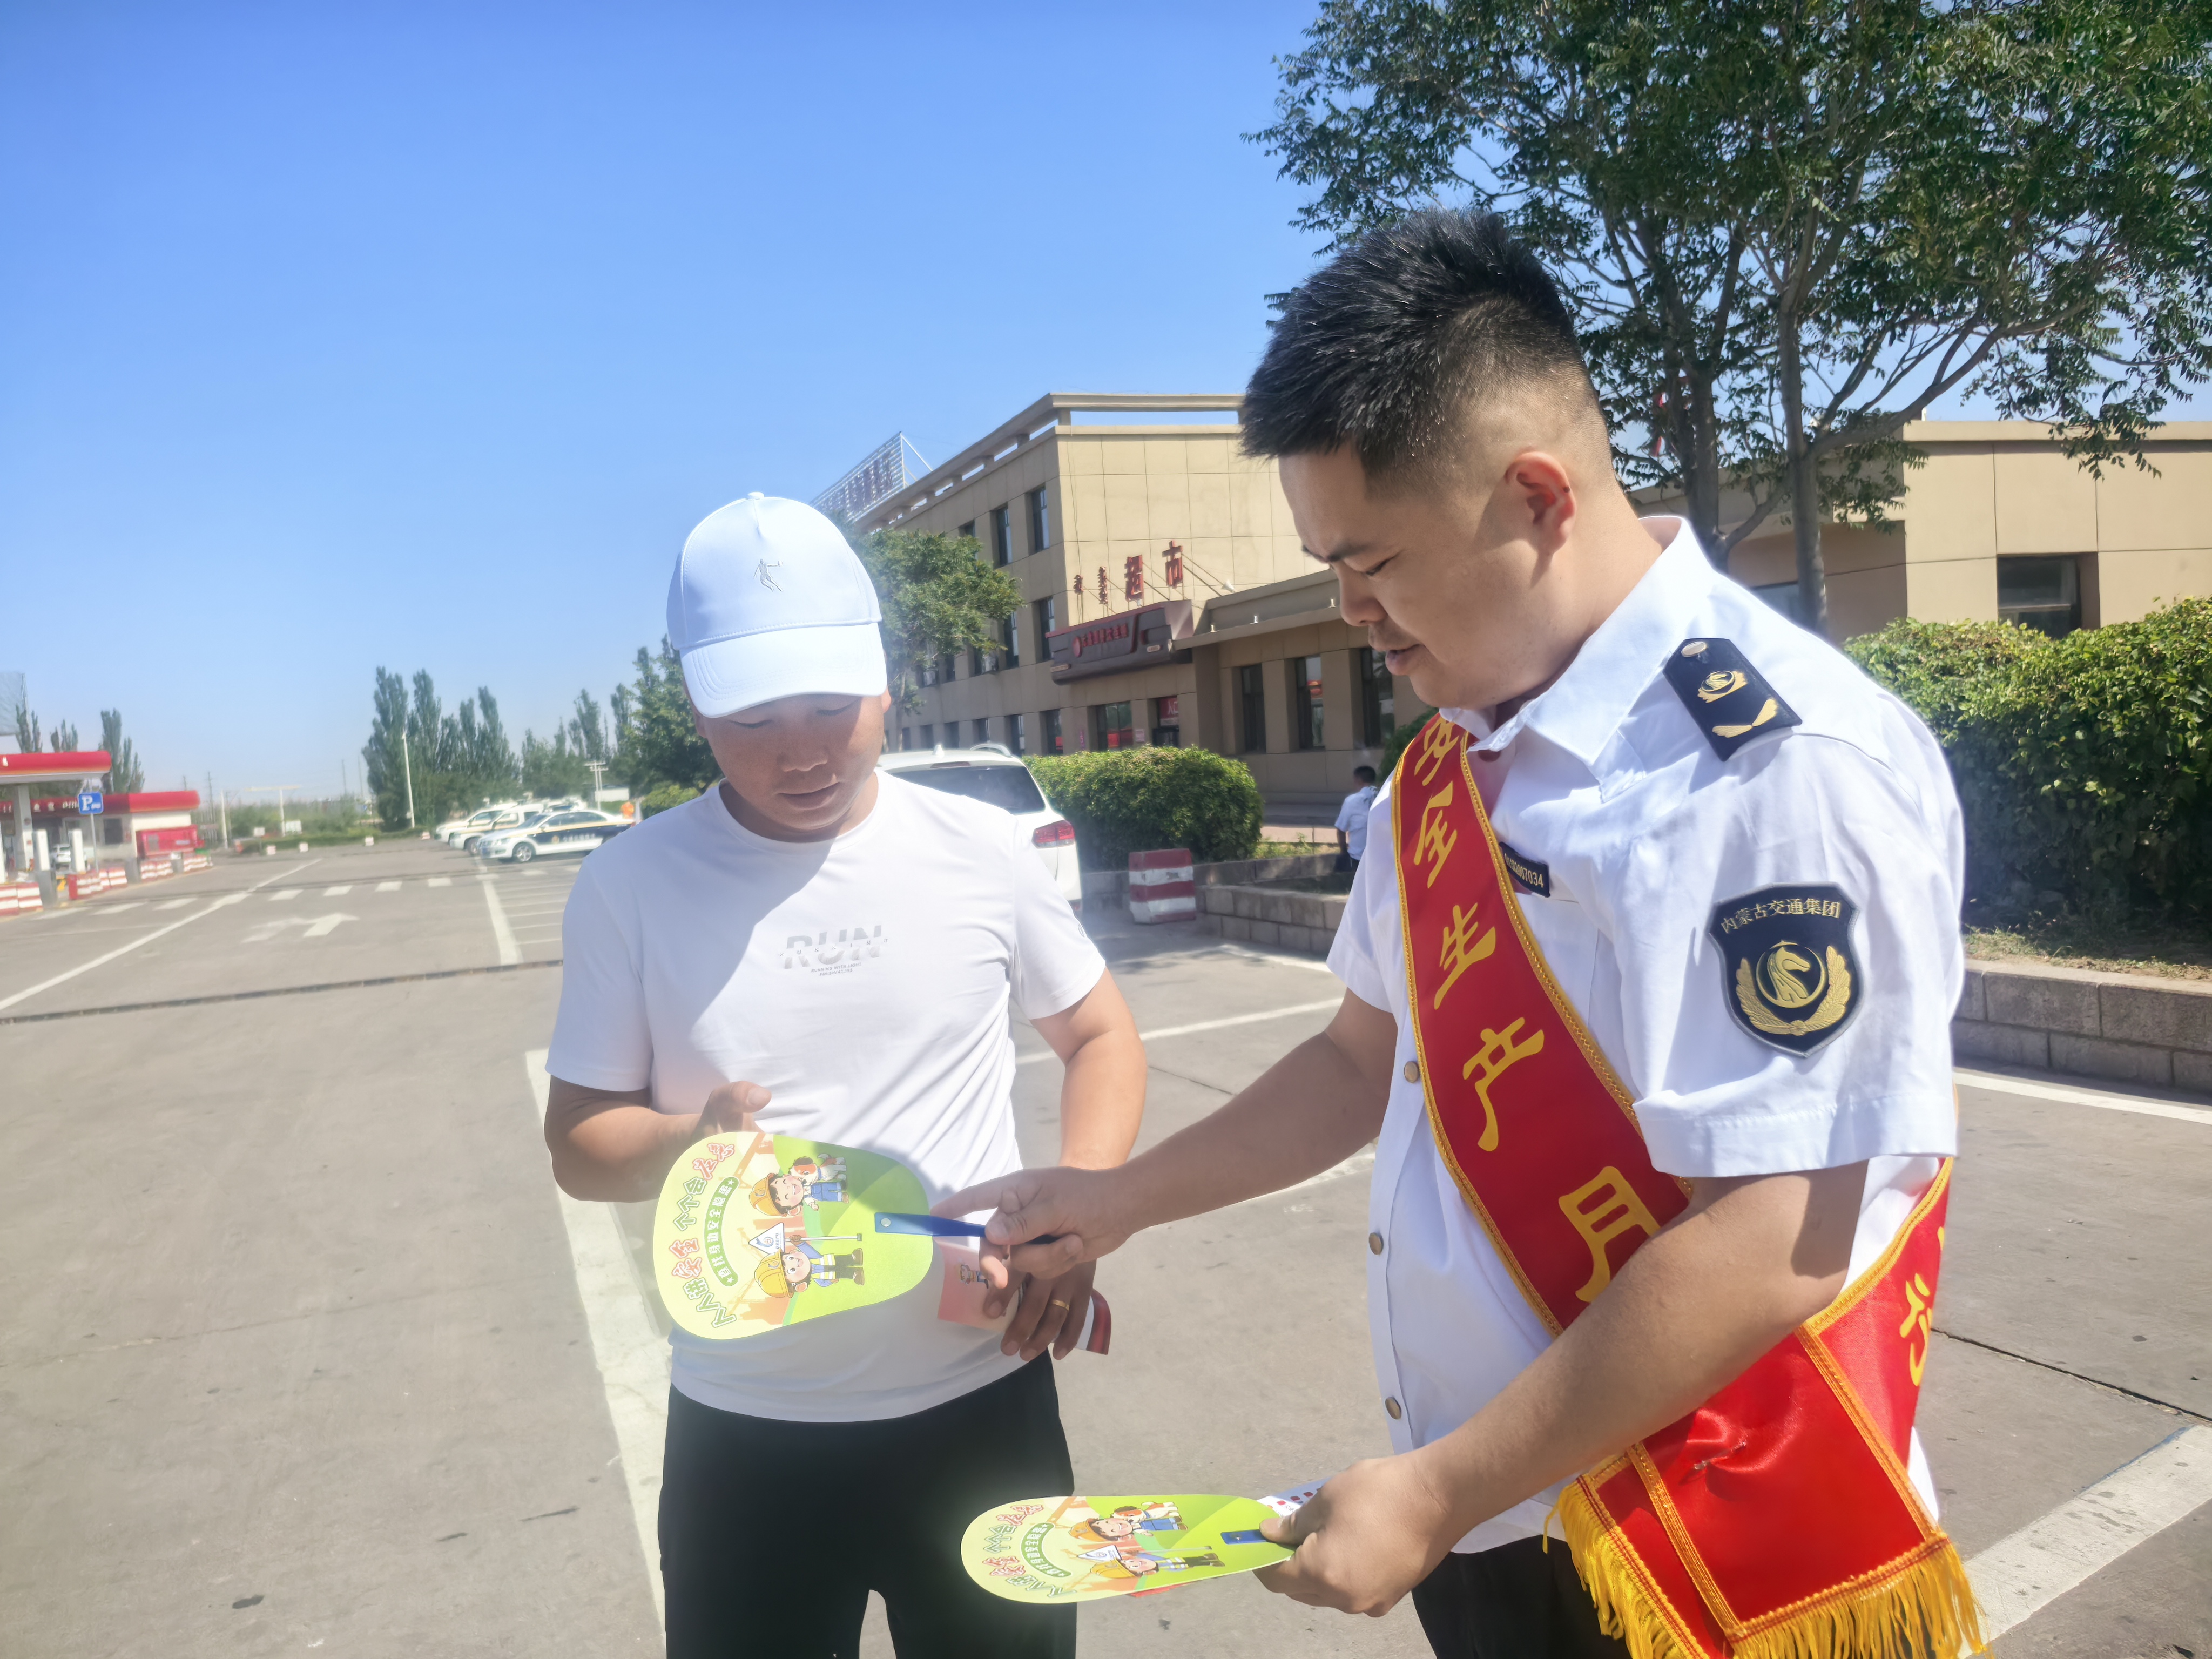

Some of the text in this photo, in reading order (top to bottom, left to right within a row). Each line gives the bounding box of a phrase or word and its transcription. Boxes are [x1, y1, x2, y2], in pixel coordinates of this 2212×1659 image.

[1124, 540, 1183, 602] 超市
[81, 795, 93, 811] P
[1721, 898, 1841, 934] 内蒙古交通集团
[784, 925, 882, 969] RUN
[669, 1142, 737, 1328] 人人讲安全 个个会应急
[705, 1184, 734, 1280] 查找身边安全隐患
